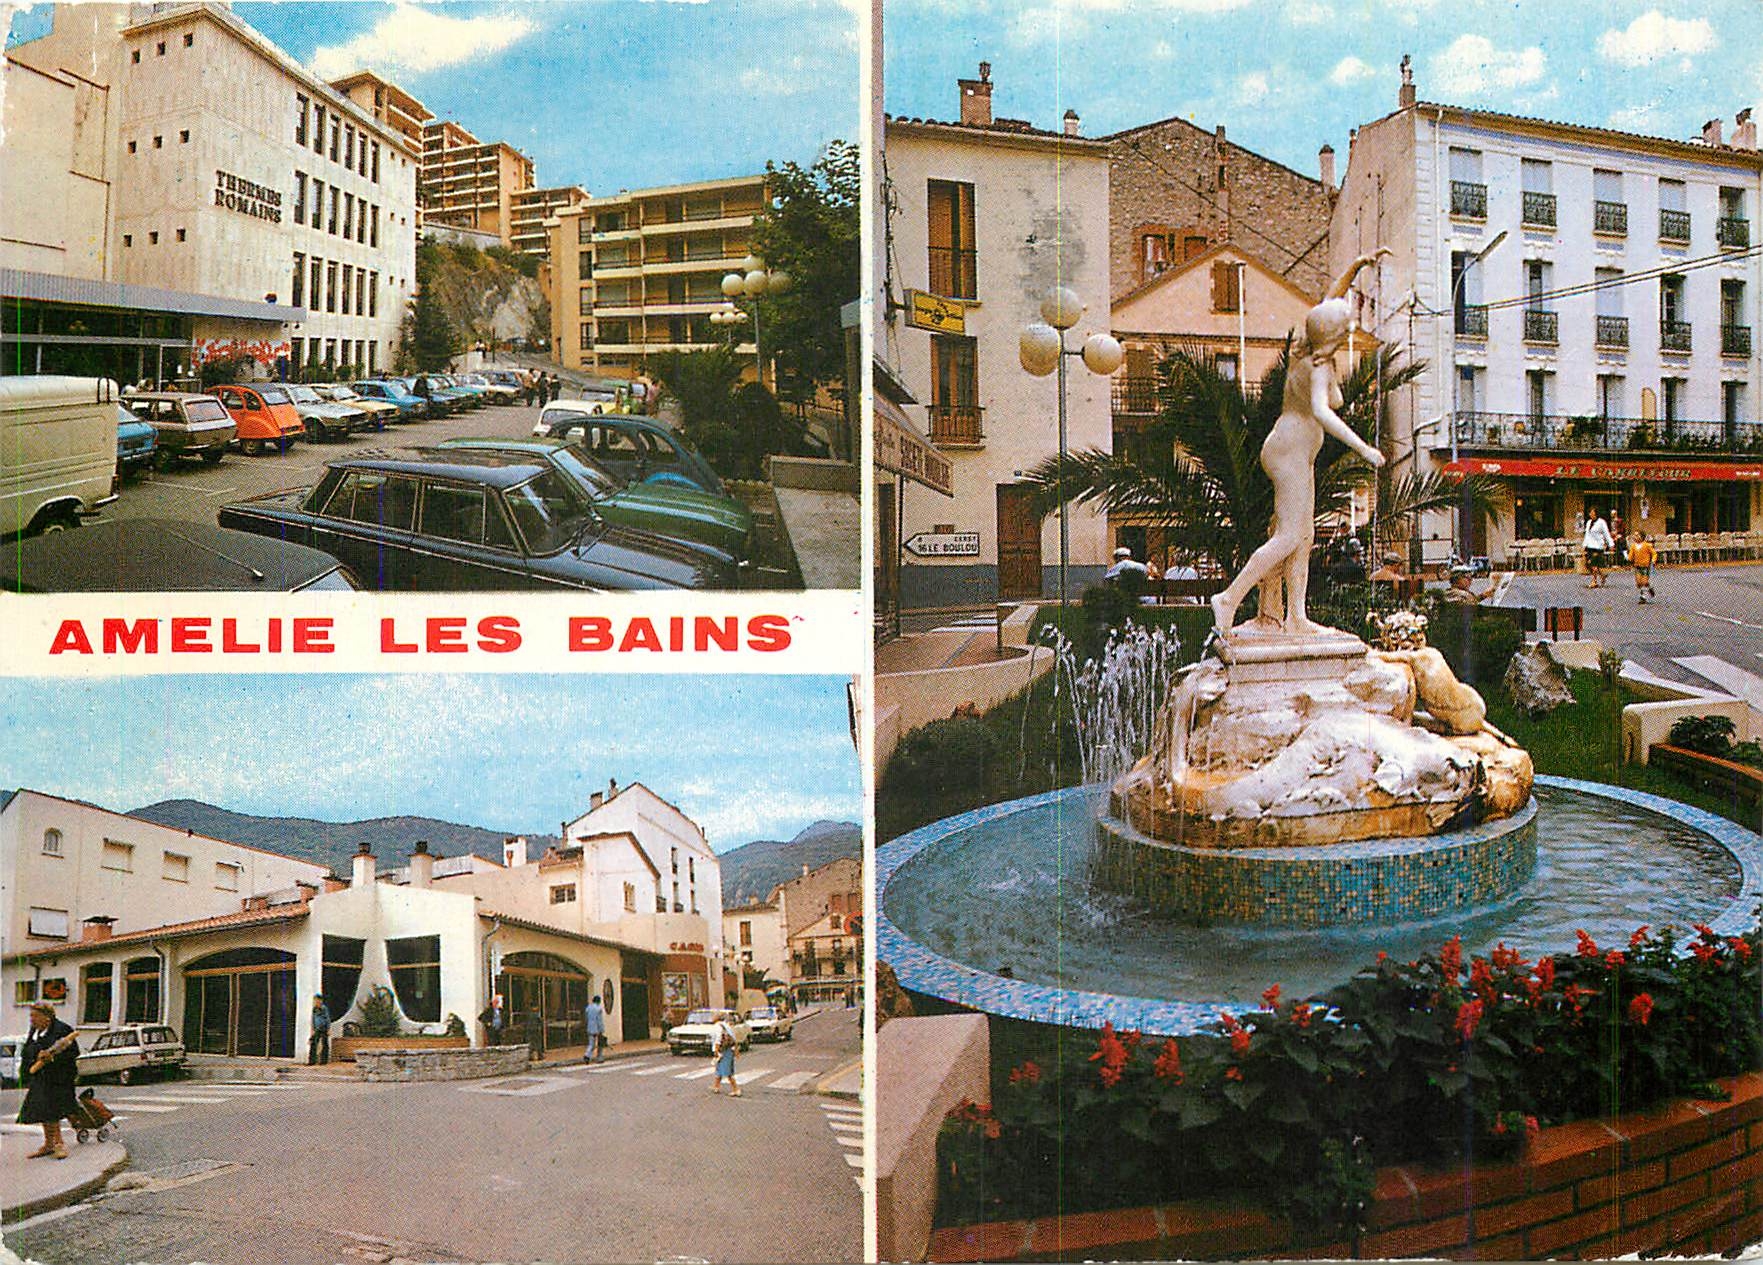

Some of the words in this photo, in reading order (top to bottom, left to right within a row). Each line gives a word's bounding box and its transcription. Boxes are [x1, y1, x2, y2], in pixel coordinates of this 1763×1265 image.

[215, 169, 282, 207] THERMES
[215, 188, 282, 223] ROMAINS
[928, 544, 939, 552] LE
[943, 543, 978, 552] BOULOU
